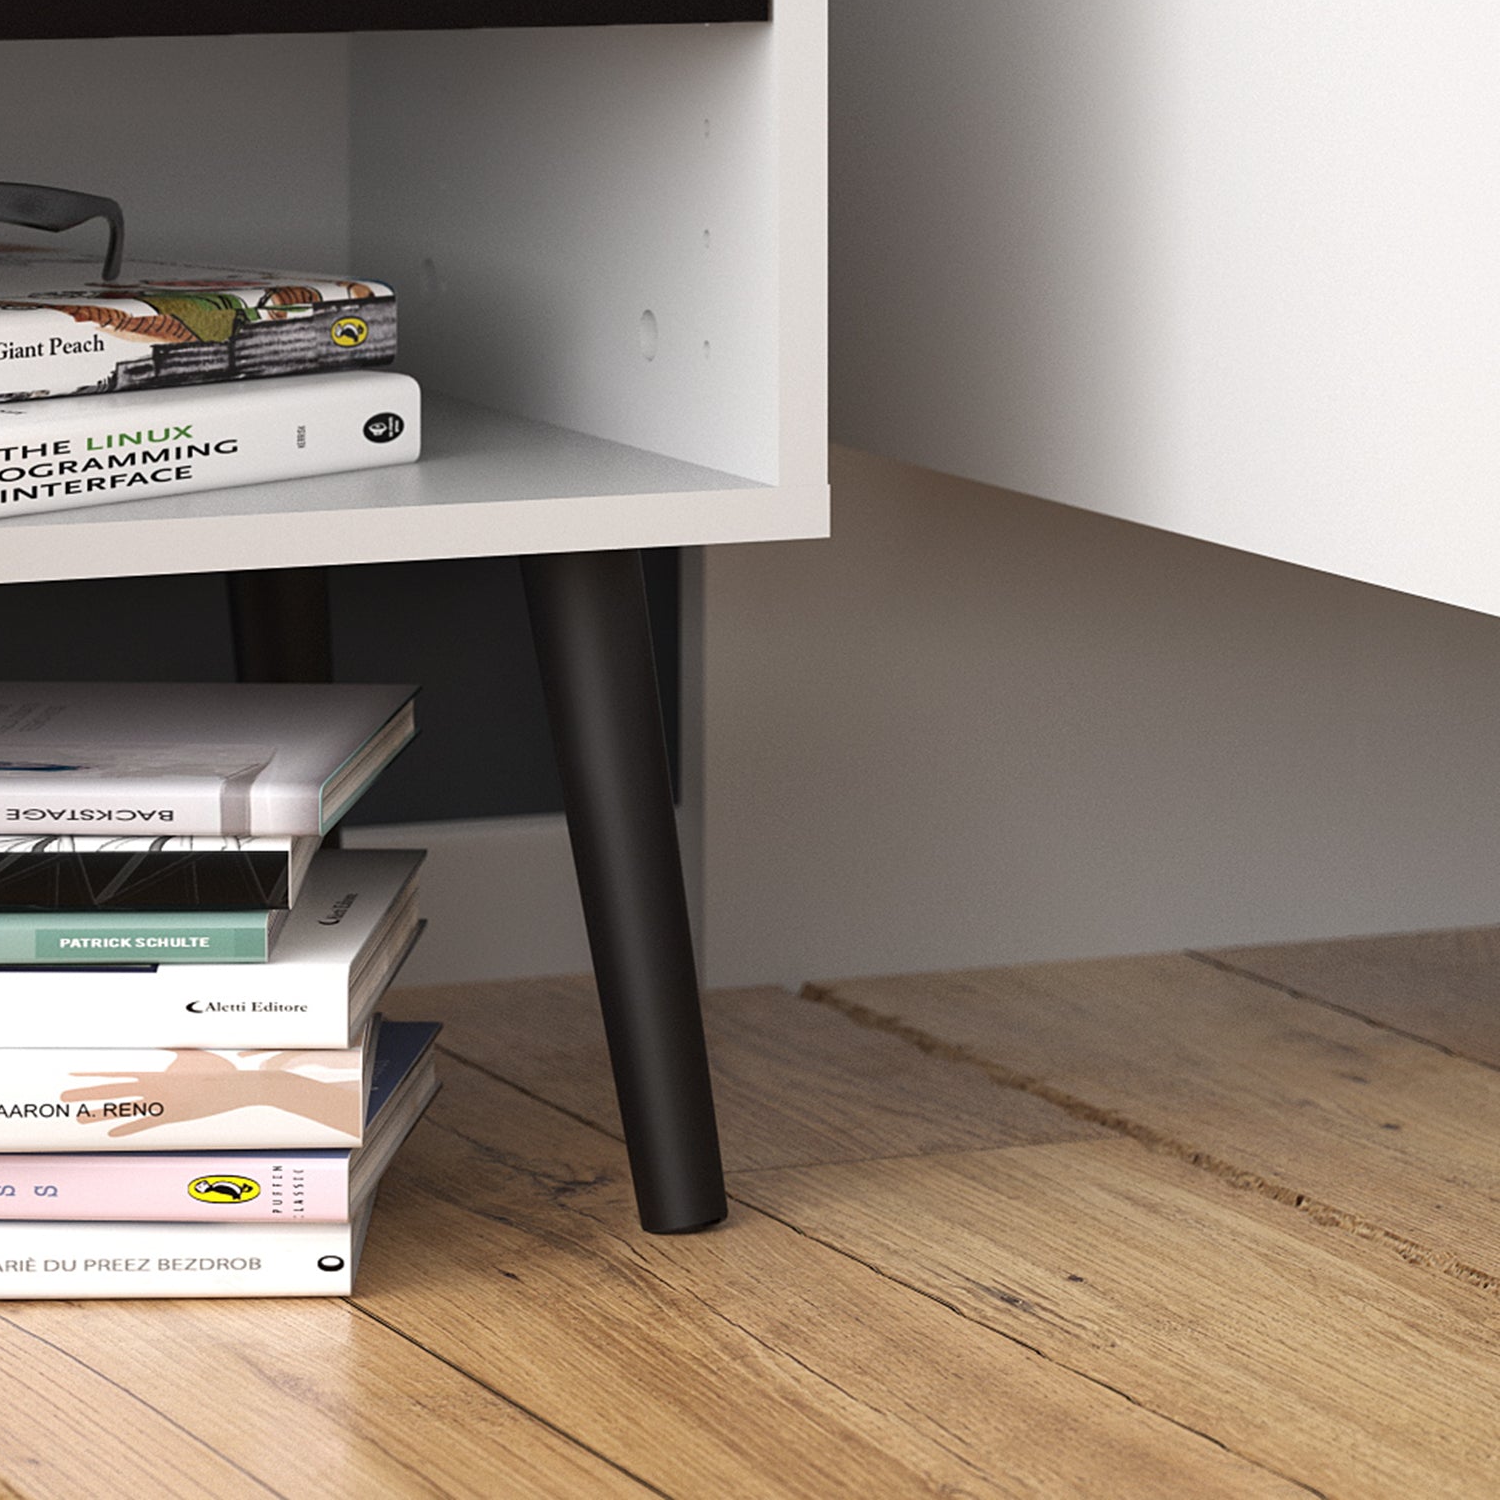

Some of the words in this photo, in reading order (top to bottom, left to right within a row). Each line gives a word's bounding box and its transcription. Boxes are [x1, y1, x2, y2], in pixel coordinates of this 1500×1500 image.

[50, 334, 105, 356] Peach
[87, 424, 194, 452] LINUX
[0, 465, 193, 504] INTERFACE
[6, 807, 175, 822] BACKSTAGE
[59, 937, 132, 949] PATRICK
[134, 936, 211, 948] SCHULTE
[206, 1000, 246, 1013] Aletti
[251, 1000, 307, 1013] Editore
[76, 1103, 97, 1118] A.
[102, 1101, 165, 1118] RENO
[271, 1165, 283, 1214] PUFFIN
[43, 1258, 77, 1273] DU
[83, 1257, 151, 1272] PREEZ
[157, 1256, 262, 1272] BEZDROB
